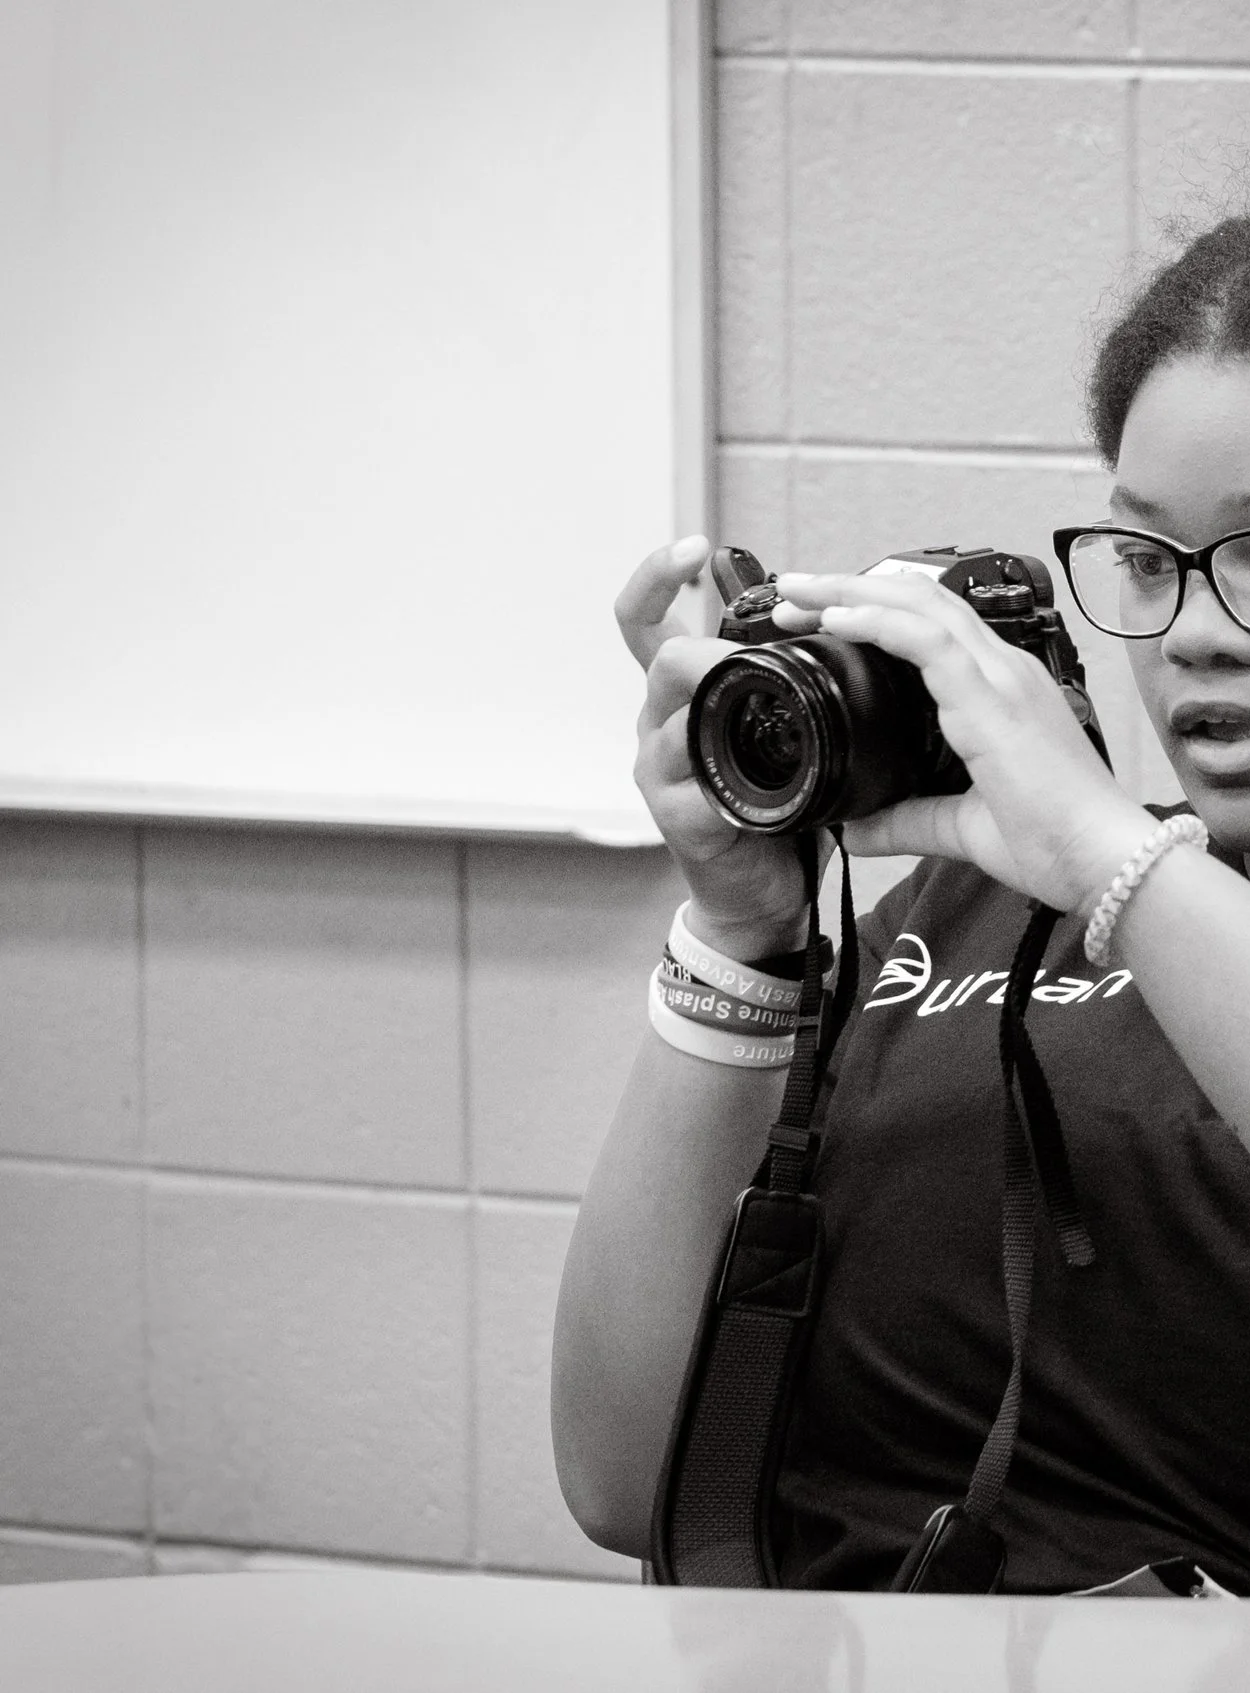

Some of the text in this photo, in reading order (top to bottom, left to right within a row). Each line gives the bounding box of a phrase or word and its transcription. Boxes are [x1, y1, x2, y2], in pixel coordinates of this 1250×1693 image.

[662, 957, 692, 984] BLAC
[667, 987, 732, 1020] Splash
[757, 983, 802, 1007] lash
[738, 1005, 797, 1029] enture
